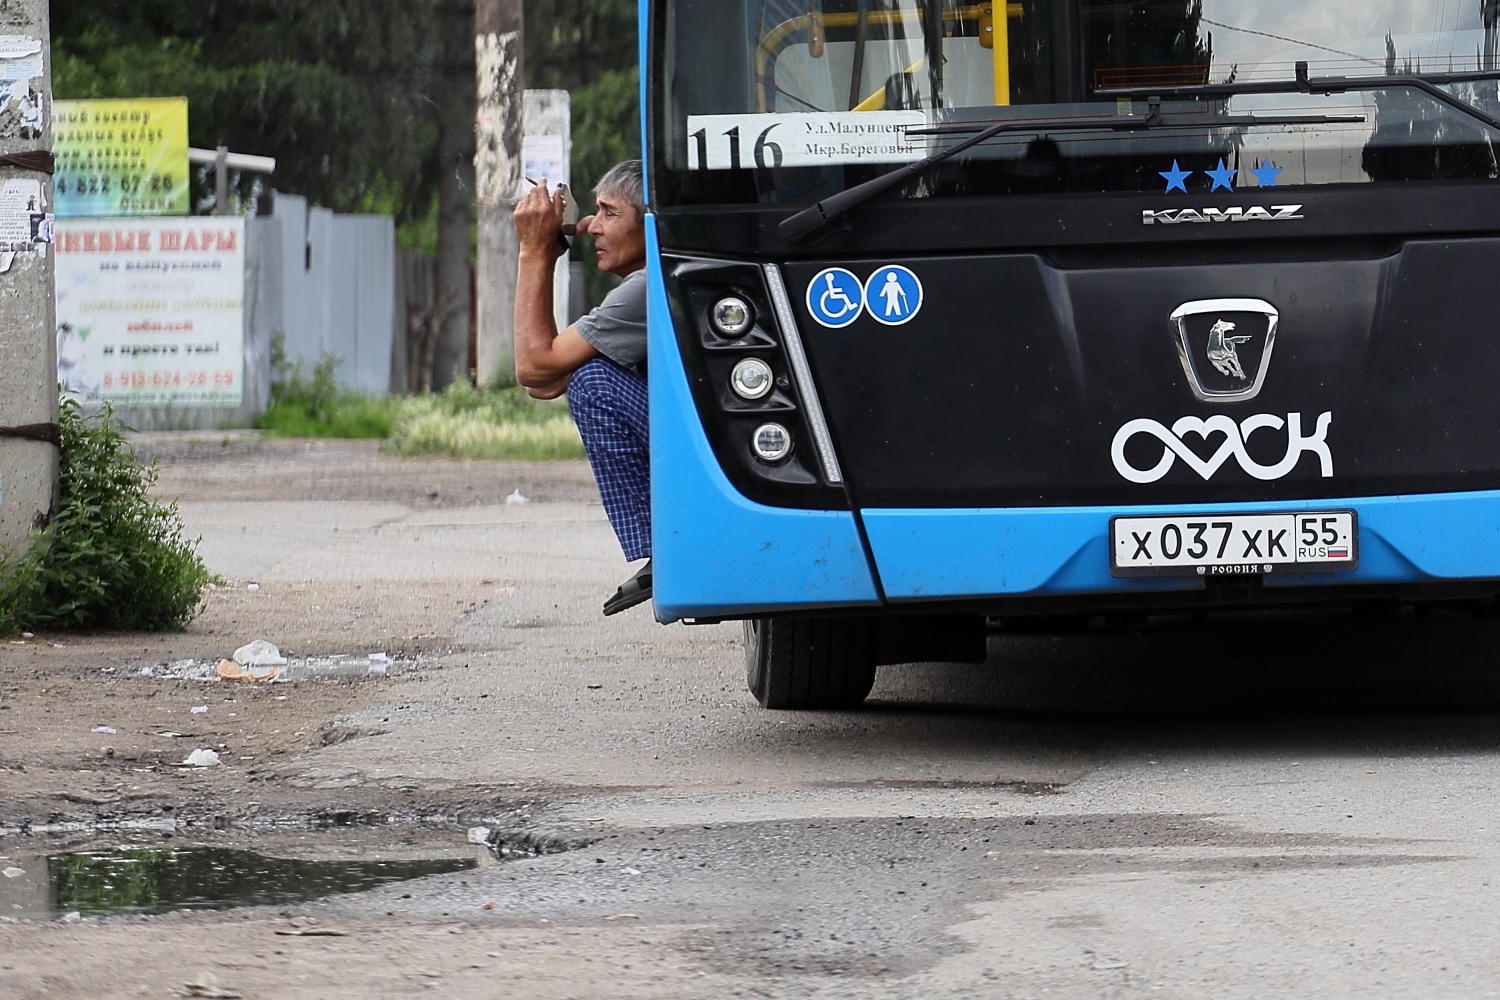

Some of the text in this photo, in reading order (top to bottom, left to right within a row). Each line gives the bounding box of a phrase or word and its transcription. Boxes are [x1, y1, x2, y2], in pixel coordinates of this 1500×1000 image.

[688, 122, 784, 170] 116
[804, 142, 913, 157] Мкр.Береговой
[1142, 204, 1305, 225] KAMAZ
[159, 229, 237, 251] ШАРЫ
[1301, 517, 1339, 547] 55
[1299, 547, 1327, 558] RUS
[1211, 564, 1259, 574] РОССИЯ
